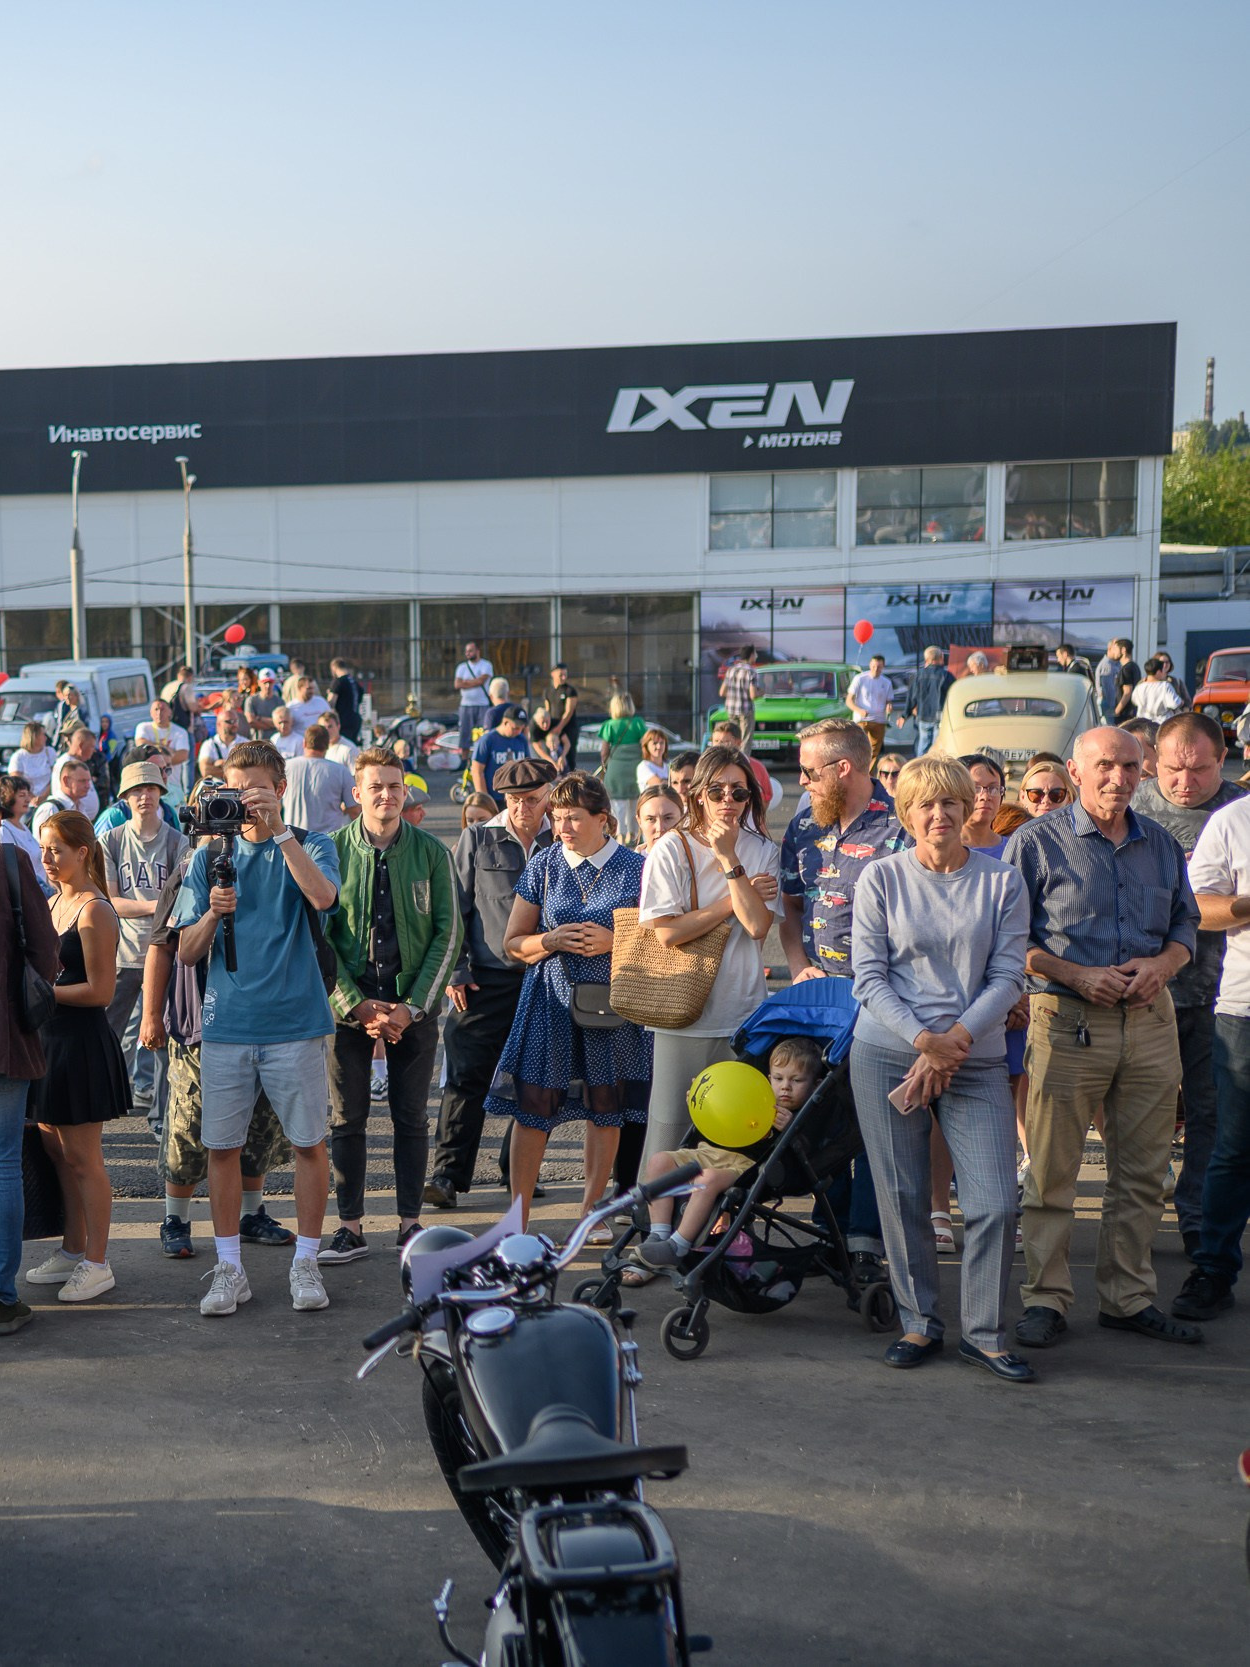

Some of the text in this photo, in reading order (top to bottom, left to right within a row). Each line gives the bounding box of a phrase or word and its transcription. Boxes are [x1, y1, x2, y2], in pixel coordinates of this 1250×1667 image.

[48, 423, 202, 445] Инавтосервис
[758, 431, 842, 449] MOTORS
[119, 861, 169, 893] GAP
